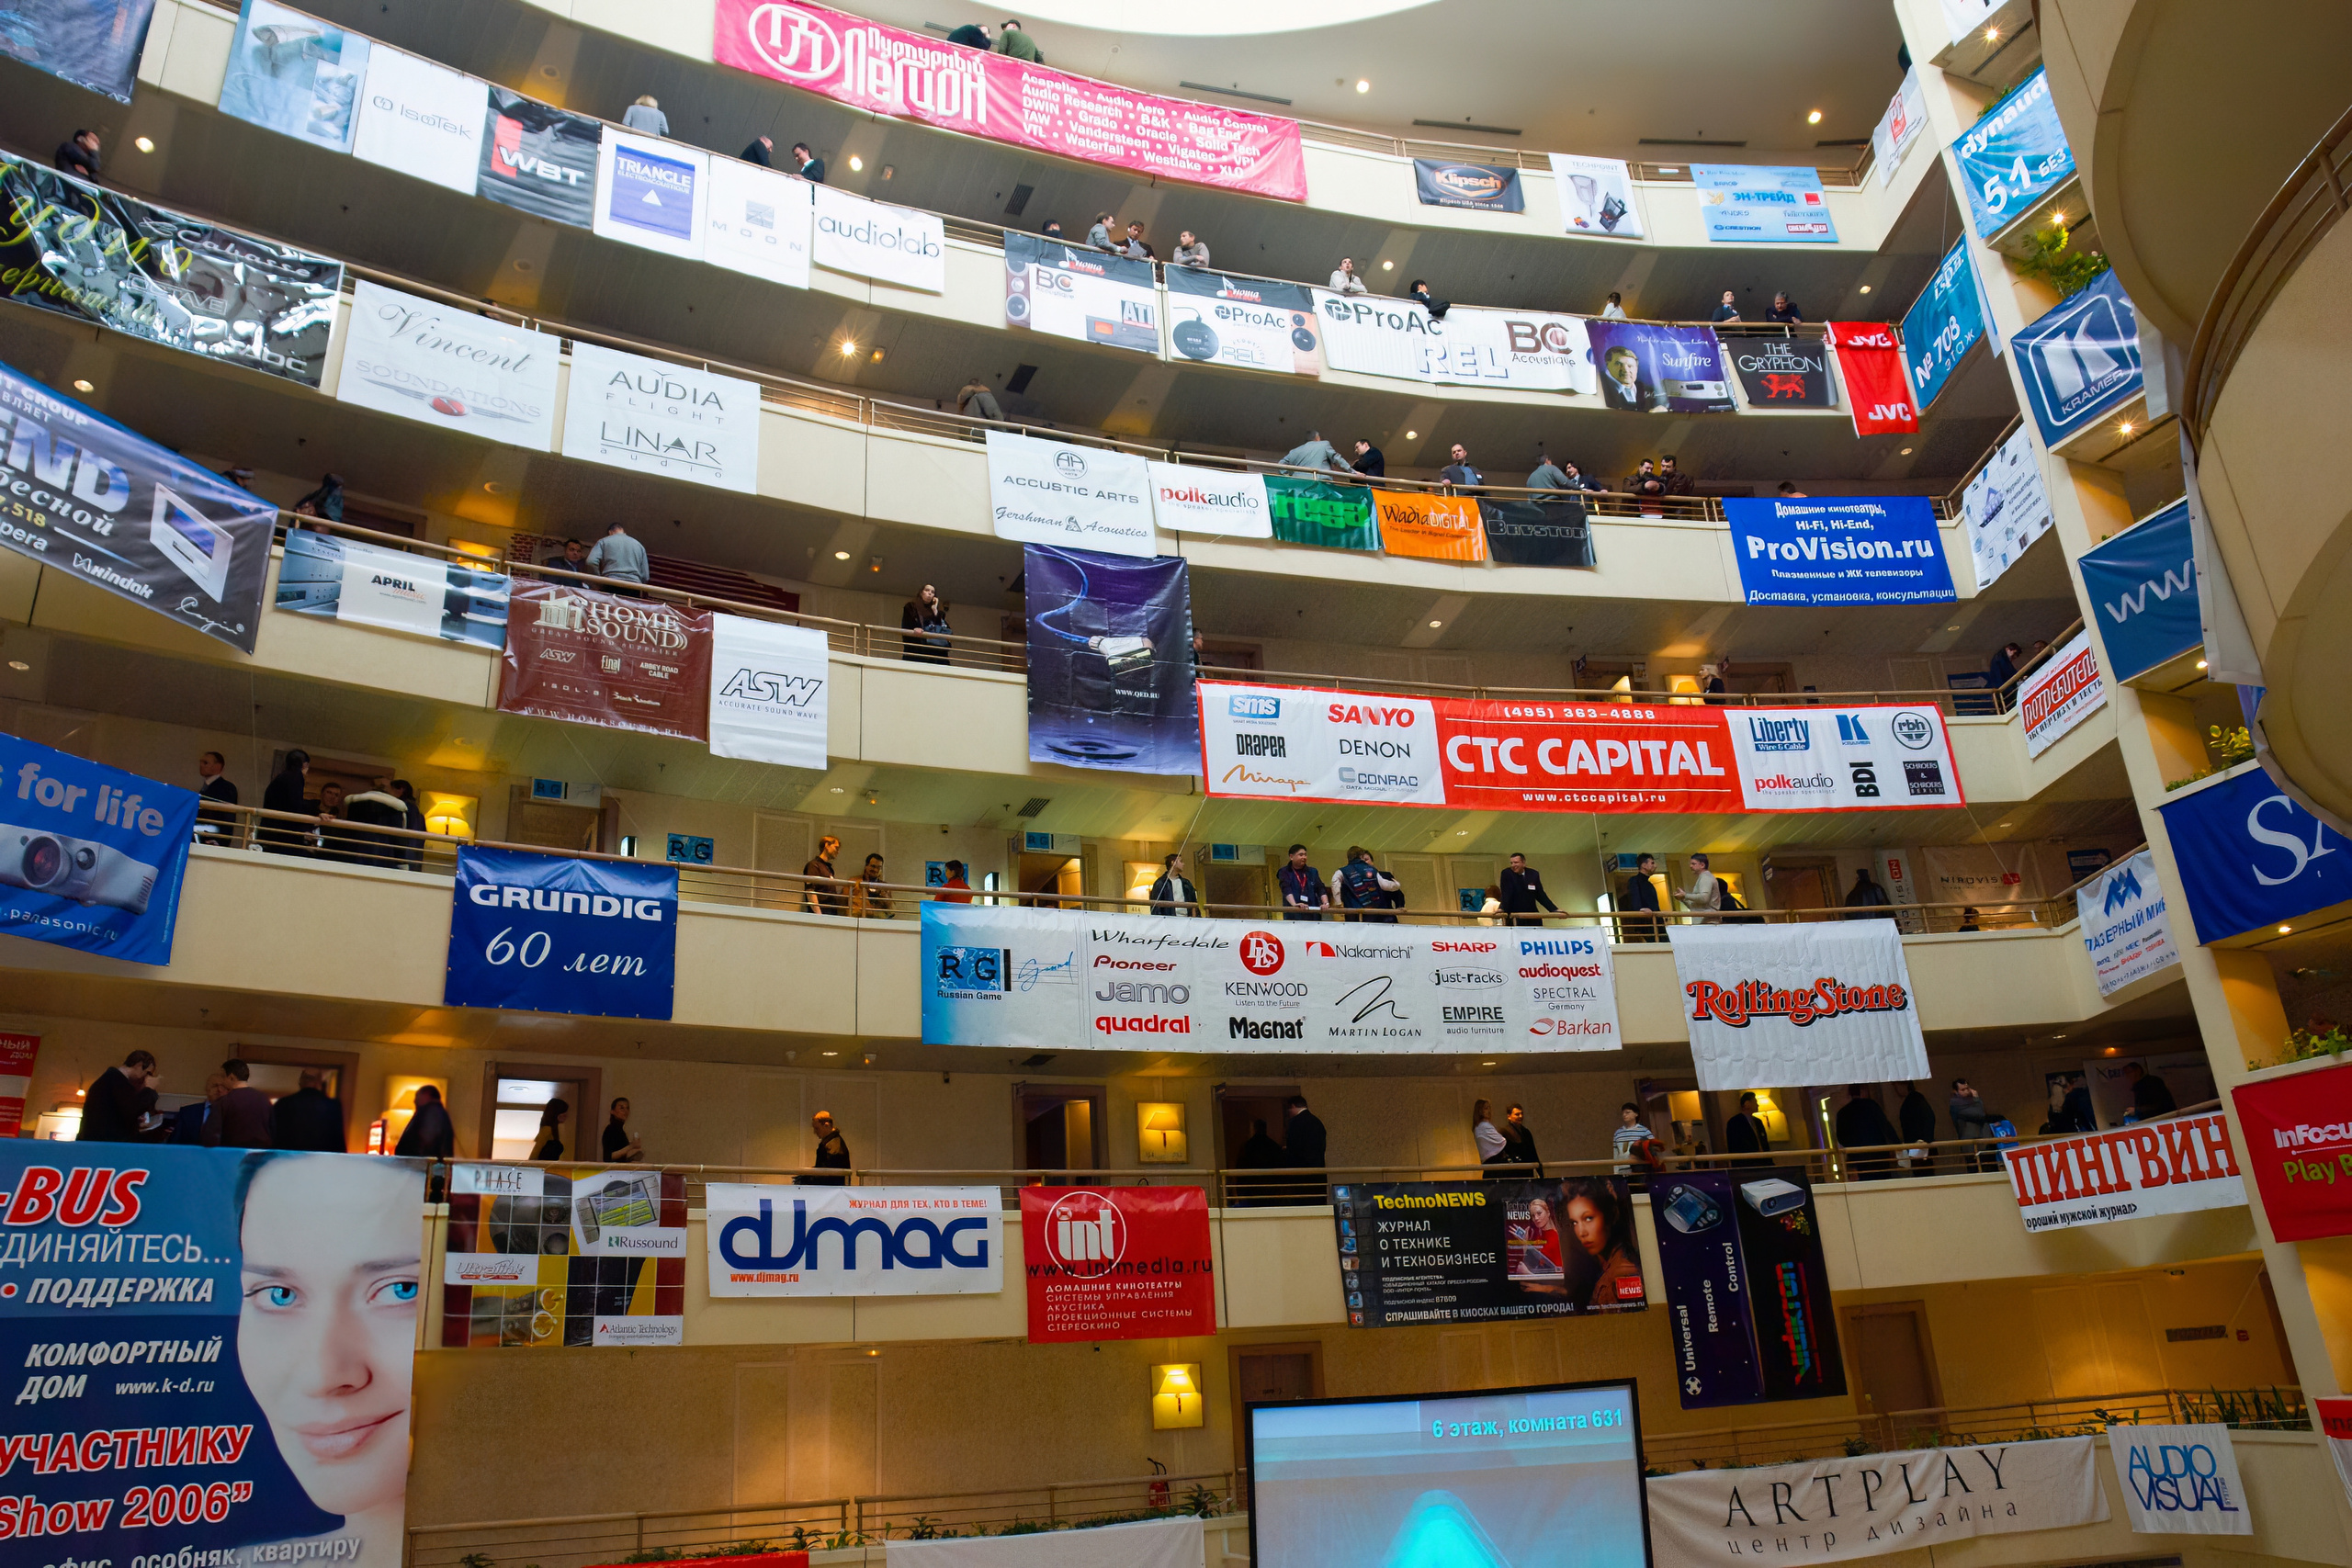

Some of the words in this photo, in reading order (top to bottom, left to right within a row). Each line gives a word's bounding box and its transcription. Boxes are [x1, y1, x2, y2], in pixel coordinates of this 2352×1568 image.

[401, 103, 471, 140] IsoTek
[1022, 84, 1060, 103] Audio
[1064, 93, 1123, 118] Research
[1141, 114, 1170, 130] B&K
[1188, 123, 1215, 141] Bag
[1217, 128, 1241, 141] End
[1023, 96, 1059, 116] DWIN
[1078, 111, 1117, 130] Grado
[1136, 126, 1178, 142] Oracle
[1195, 138, 1228, 152] Solid
[1231, 141, 1260, 156] Tech
[498, 145, 585, 185] WBT
[617, 156, 692, 187] TRIANGLE
[1435, 171, 1502, 190] Klipsch
[1984, 156, 2031, 215] 5.1
[1733, 191, 1796, 204] ЭН-ТРЕЙД
[818, 215, 940, 258] audiolab
[1232, 306, 1285, 328] ProAc
[1352, 302, 1443, 335] ProAc
[379, 304, 535, 374] Vincent
[1505, 321, 1573, 355] BC
[1763, 343, 1792, 355] THE
[1511, 353, 1576, 367] Acoustique
[1662, 352, 1712, 369] Sunfire
[1738, 355, 1823, 372] GRYPHON
[356, 360, 541, 418] SOUNDATIONS
[609, 370, 725, 411] AUDIA
[2062, 368, 2125, 414] KRAMER
[1868, 403, 1912, 422] JVC
[601, 422, 721, 465] LINAR
[1003, 475, 1089, 496] ACCUSTIC
[1095, 491, 1139, 504] ARTS
[1275, 494, 1368, 529] rega
[1774, 502, 1826, 518] Домашние
[1827, 503, 1886, 517] кинотеатры,
[996, 506, 1063, 527] Gershman
[1083, 520, 1148, 538] Acoustics
[1746, 535, 1935, 561] ProVision.ru
[371, 574, 415, 592] APRIL
[1771, 569, 1836, 579] Плазменные
[1846, 569, 1863, 578] ЖК
[1865, 569, 1924, 579] телевизоры
[587, 602, 680, 634] HOME
[649, 670, 670, 680] CABLE
[719, 668, 823, 707] ASW
[1115, 688, 1160, 699] WWW.QED.RU
[718, 700, 762, 712] ACCURATE
[764, 706, 793, 716] SOUND
[797, 710, 818, 719] WAVE
[1328, 704, 1415, 728] SANYO
[1504, 707, 1555, 718] (495)
[1564, 708, 1655, 719] 363-4888
[1748, 716, 1808, 742] Liberty
[1897, 718, 1926, 731] rbh
[1340, 739, 1410, 758] DENON
[1446, 735, 1528, 774] CTC
[1537, 739, 1725, 776] CAPITAL
[1222, 764, 1311, 792] Mirage
[1849, 761, 1880, 797] BDI
[17, 762, 87, 813] for
[95, 784, 164, 837] life
[1522, 793, 1667, 804] www.ctccapital.ru
[469, 884, 662, 921] GRUNDIG
[1091, 930, 1229, 950] Wharfedale
[1431, 942, 1497, 953] SHARP
[1521, 941, 1594, 955] PHILIPS
[485, 927, 551, 967] 60
[563, 952, 647, 976] лет
[1335, 945, 1411, 959] Nakamichi
[2120, 951, 2143, 965] SHARP
[2145, 938, 2165, 952] TOSHIBA
[1093, 954, 1177, 972] Pioneer
[1519, 964, 1602, 981] audioquest
[1435, 969, 1502, 985] just-racks
[937, 990, 973, 999] Russian
[976, 992, 1002, 1001] Game
[1095, 982, 1190, 1004] Jamo
[1226, 982, 1307, 997] KENWOOD
[1533, 987, 1596, 998] SPECTRAL
[1442, 1007, 1504, 1020] EMPIRE
[1095, 1015, 1191, 1034] quadral
[1329, 1027, 1377, 1037] MARTIN
[1383, 1027, 1422, 1037] LOGAN
[1557, 1019, 1611, 1036] Barkan
[2007, 1115, 2240, 1207] ПИНГВИН
[475, 1170, 522, 1190] PHASE
[2284, 1159, 2335, 1185] Play
[849, 1200, 888, 1209] ЖУРНАЛ
[890, 1200, 910, 1210] ДЛЯ
[912, 1200, 931, 1210] ТЕХ,
[962, 1200, 988, 1208] ТЕМЕ!
[1374, 1192, 1487, 1210] TechnoNEWS
[1507, 1211, 1531, 1220] NEWS
[1378, 1220, 1430, 1234] ЖУРНАЛ
[619, 1237, 678, 1248] Russound
[1379, 1239, 1387, 1251] О
[1393, 1236, 1451, 1251] ТЕХНИКЕ
[1026, 1258, 1212, 1277] www.intmedia.ru
[1381, 1257, 1390, 1269] И
[1394, 1253, 1497, 1268] ТЕХНОБИЗНЕСЕ
[1723, 1242, 1739, 1292] Control
[730, 1272, 800, 1284] www.djmag.ru
[1046, 1283, 1112, 1293] ДОМАШНИЕ
[1115, 1281, 1182, 1290] КИНОТЕАТРЫ
[26, 1277, 214, 1308] ПОДДЕРЖКА
[1046, 1293, 1101, 1303] СИСТЕМЫ
[1105, 1291, 1174, 1301] УПРАВЛЕНИЯ
[1620, 1287, 1641, 1295] NEWS
[1046, 1303, 1105, 1313] АКУСТИКА
[1047, 1311, 1136, 1322] ПРОЕКЦИОННЫЕ
[1141, 1309, 1193, 1318] СИСТЕМЫ
[1385, 1309, 1451, 1322] СПРАШИВАЙТЕ
[1452, 1310, 1458, 1319] В
[1460, 1307, 1499, 1319] КИОСКАХ
[1500, 1304, 1534, 1316] ВАШЕГО
[1536, 1302, 1574, 1314] ГОРОДА!
[1703, 1280, 1719, 1333] Remote
[1047, 1321, 1121, 1331] СТЕРЕОКИНО
[1677, 1304, 1696, 1371] Universal
[25, 1336, 223, 1367] КОМФОРТНЫЙ
[16, 1374, 87, 1405] ДОМ
[115, 1379, 215, 1395] www.k-d.ru
[1431, 1420, 1444, 1439] 6
[1449, 1420, 1504, 1438] этаж,
[1508, 1415, 1588, 1435] комната
[1590, 1408, 1623, 1429] 631
[0, 1425, 254, 1477] УЧАСТНИКУ
[2128, 1444, 2215, 1478] AUDIO
[1724, 1446, 2009, 1529] ARTPLAY
[1727, 1530, 1836, 1555] центр
[1866, 1498, 2018, 1543] дизайна
